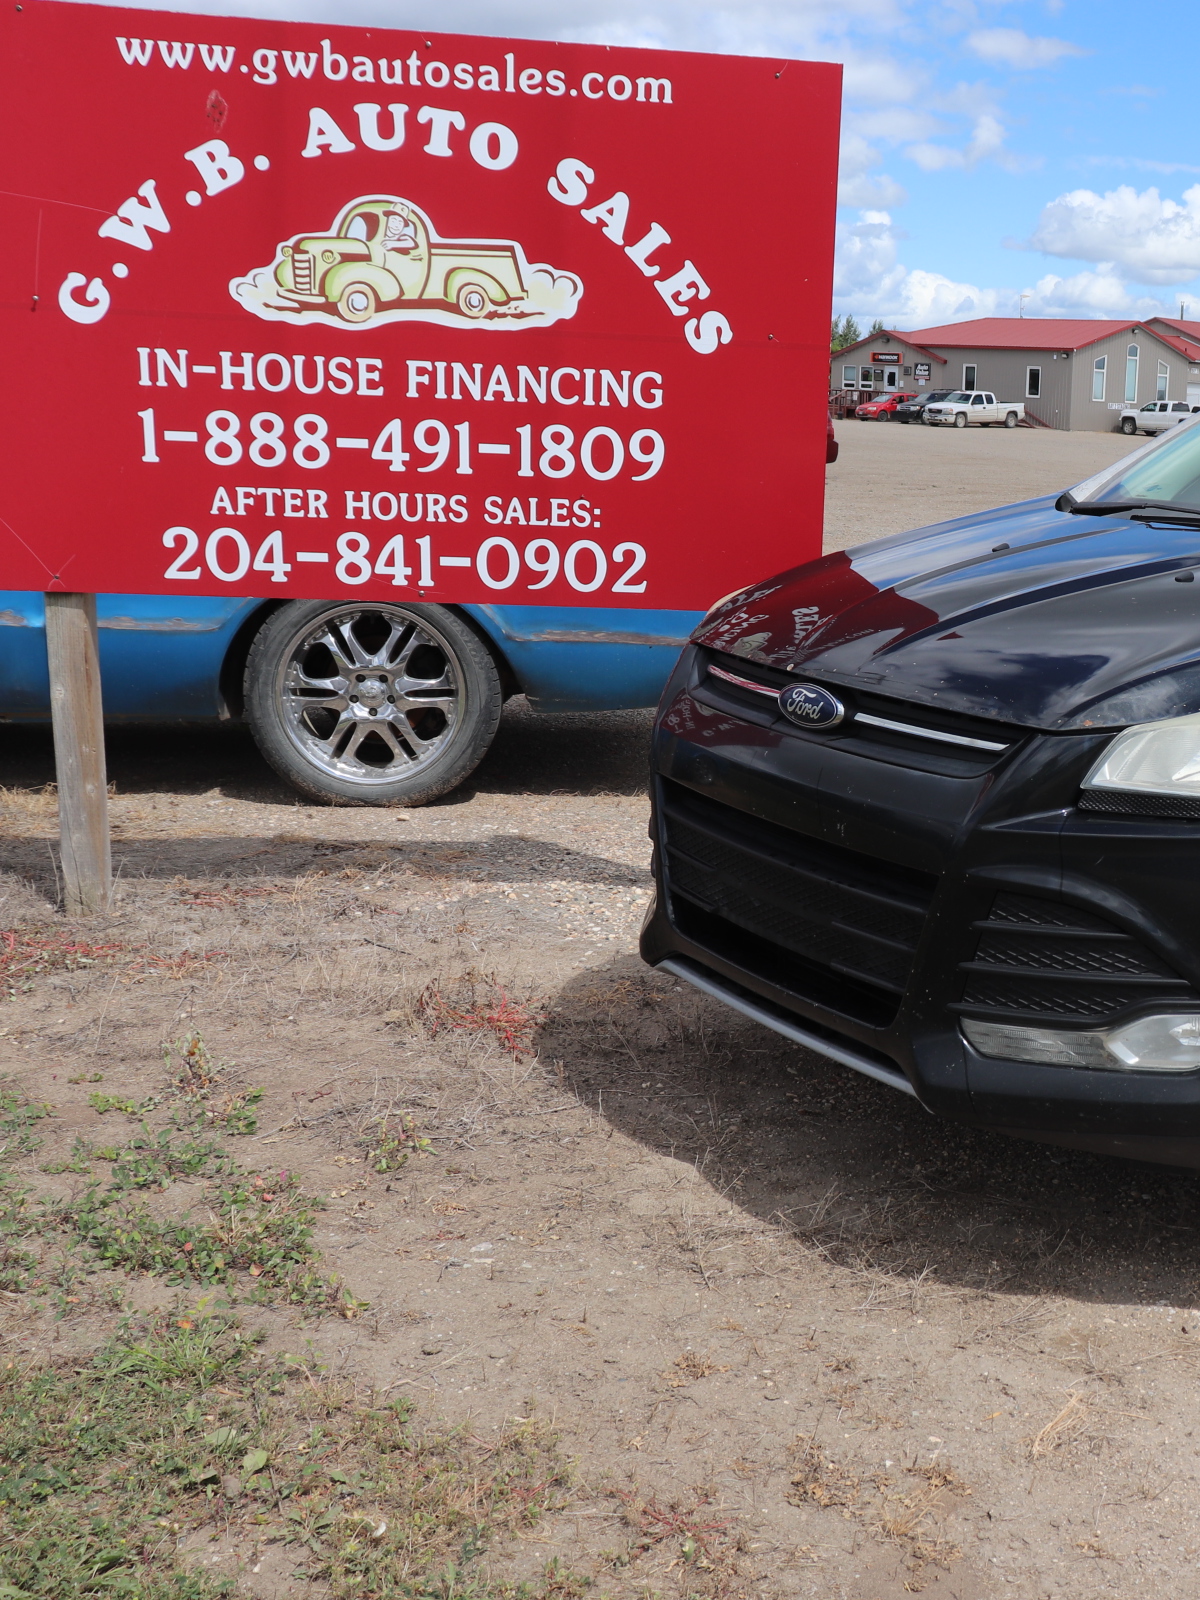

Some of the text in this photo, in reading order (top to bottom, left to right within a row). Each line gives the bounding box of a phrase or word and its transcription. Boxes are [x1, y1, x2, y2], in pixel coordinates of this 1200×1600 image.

[115, 36, 674, 105] www.gwbautosales.com
[58, 102, 734, 356] G.W.B. AUTO SALES
[136, 347, 664, 410] IN-HOUSE FINANCING
[137, 407, 666, 483] 1-888-491-1809
[209, 486, 601, 528] AFTER HOURS SALES:
[162, 526, 649, 594] 204-841-0902
[787, 688, 824, 720] Ford
